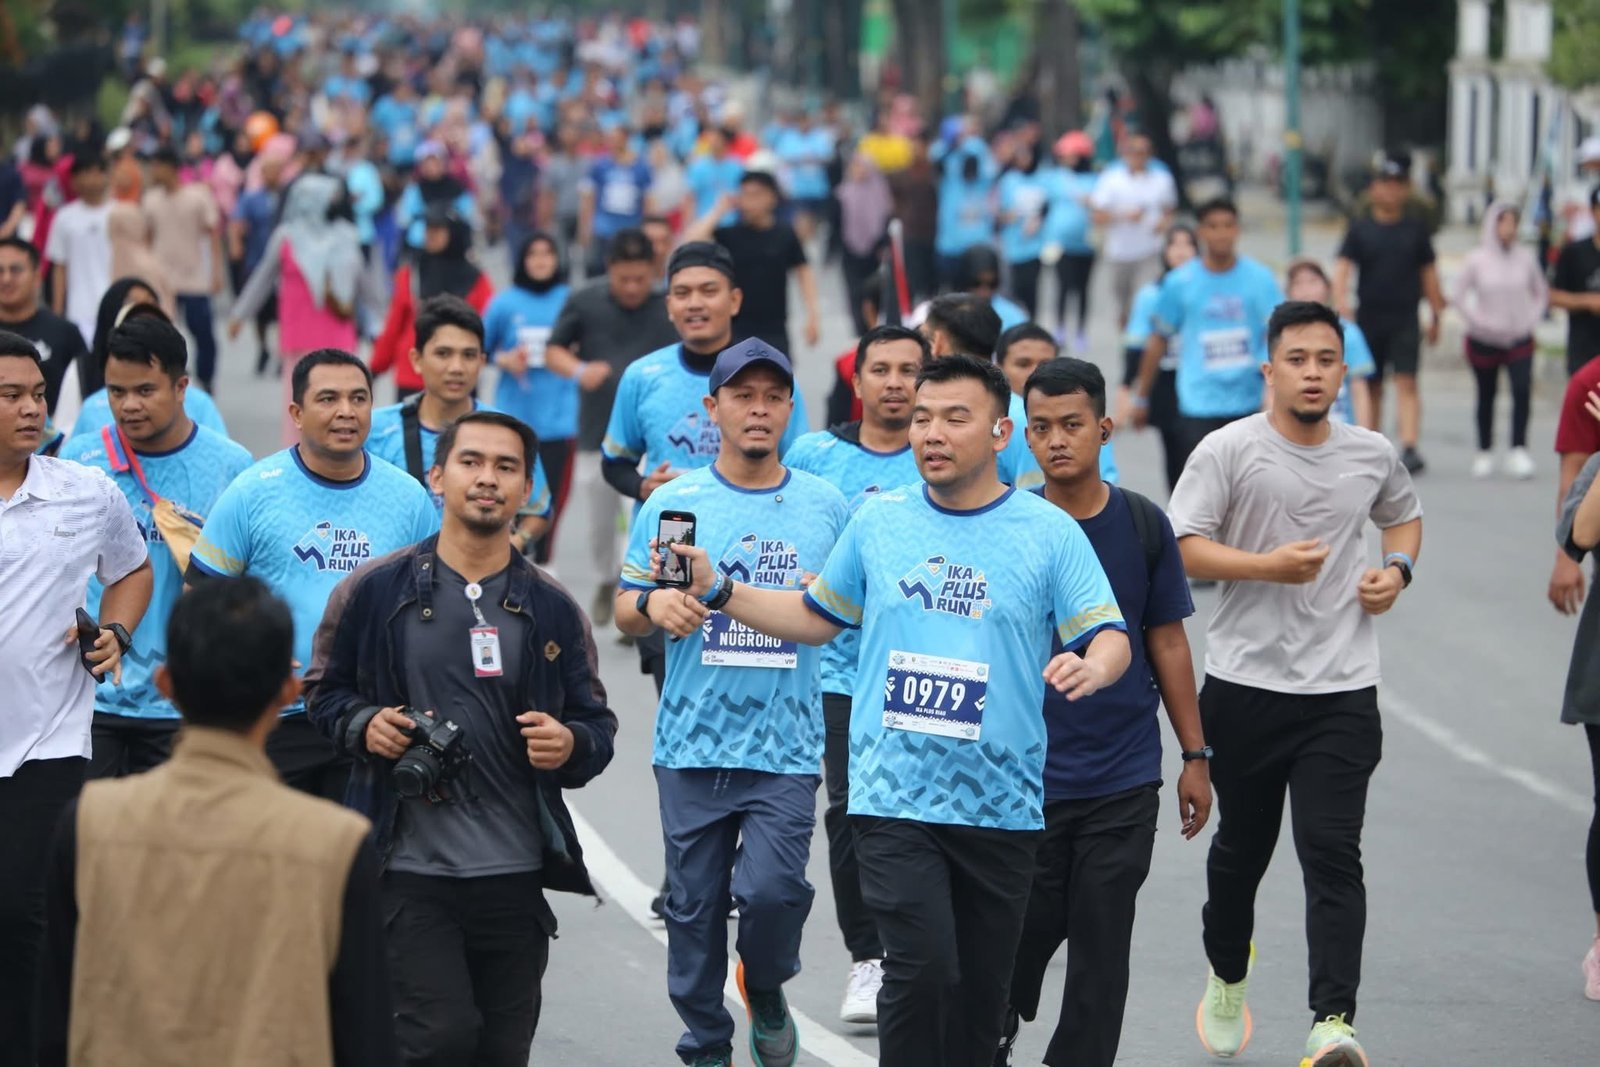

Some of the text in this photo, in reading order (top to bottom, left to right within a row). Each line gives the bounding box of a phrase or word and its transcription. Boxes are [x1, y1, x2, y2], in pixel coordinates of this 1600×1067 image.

[334, 529, 357, 541] IKA
[330, 542, 370, 558] PLUS
[760, 541, 784, 553] IKA
[328, 558, 359, 572] RUN
[756, 553, 798, 570] PLUS
[754, 571, 785, 585] RUN
[947, 565, 973, 579] IKA
[940, 580, 987, 600] PLUS
[936, 597, 972, 616] RUN
[902, 675, 966, 711] 0979
